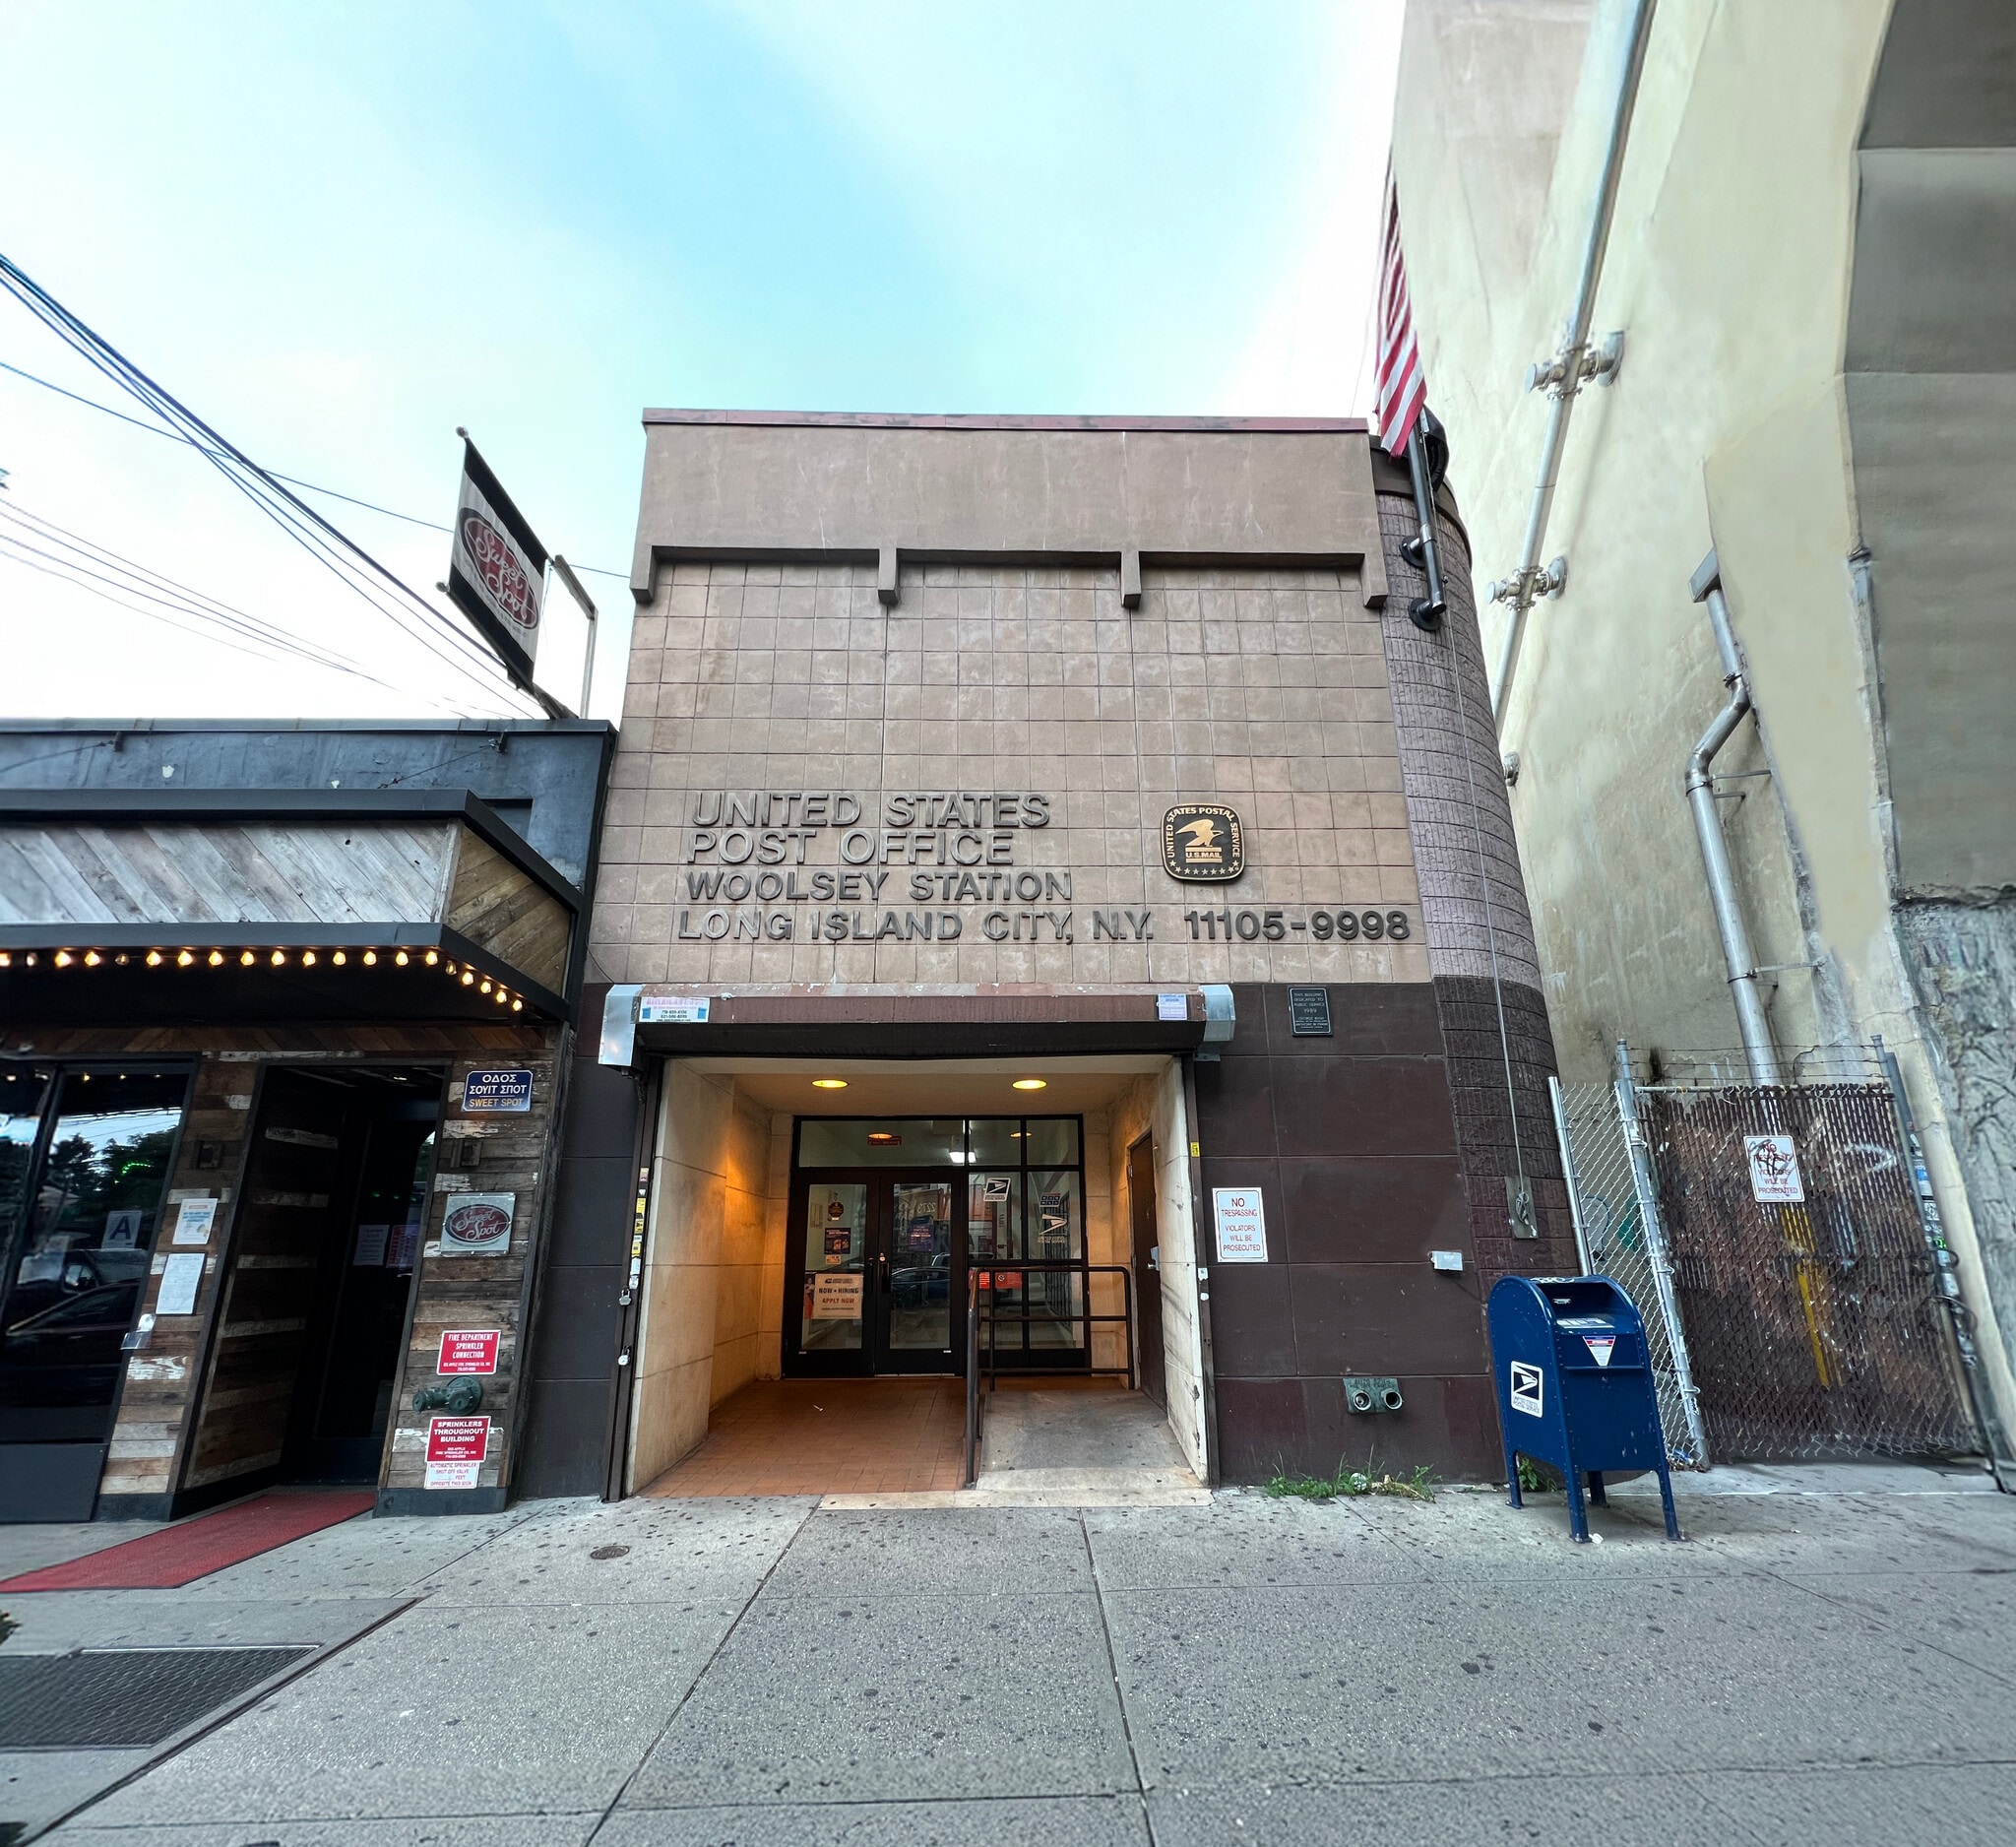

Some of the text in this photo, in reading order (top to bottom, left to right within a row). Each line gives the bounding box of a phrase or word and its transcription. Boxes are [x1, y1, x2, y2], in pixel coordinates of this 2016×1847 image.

[475, 529, 525, 590] Sweet
[486, 569, 532, 621] Spot
[692, 793, 1049, 828] UNITED STATES
[688, 829, 1013, 864] POST OFFICE
[1166, 807, 1240, 859] UNITED STATES POSTAL SERVICE
[685, 871, 1072, 901] WOOLSEY STATION
[679, 909, 1411, 944] LONG ISLAND CITY, N.Y. 11105-9998
[469, 1085, 527, 1094] ΣΟΥΙΤ ΣΠΟΤ
[482, 1074, 517, 1083] ΟΔΟΣ
[469, 1098, 523, 1107] SWEET SPOT
[1231, 1198, 1245, 1207] NO
[109, 1215, 131, 1240] A
[456, 1210, 496, 1231] Sweet
[466, 1220, 505, 1240] Spot
